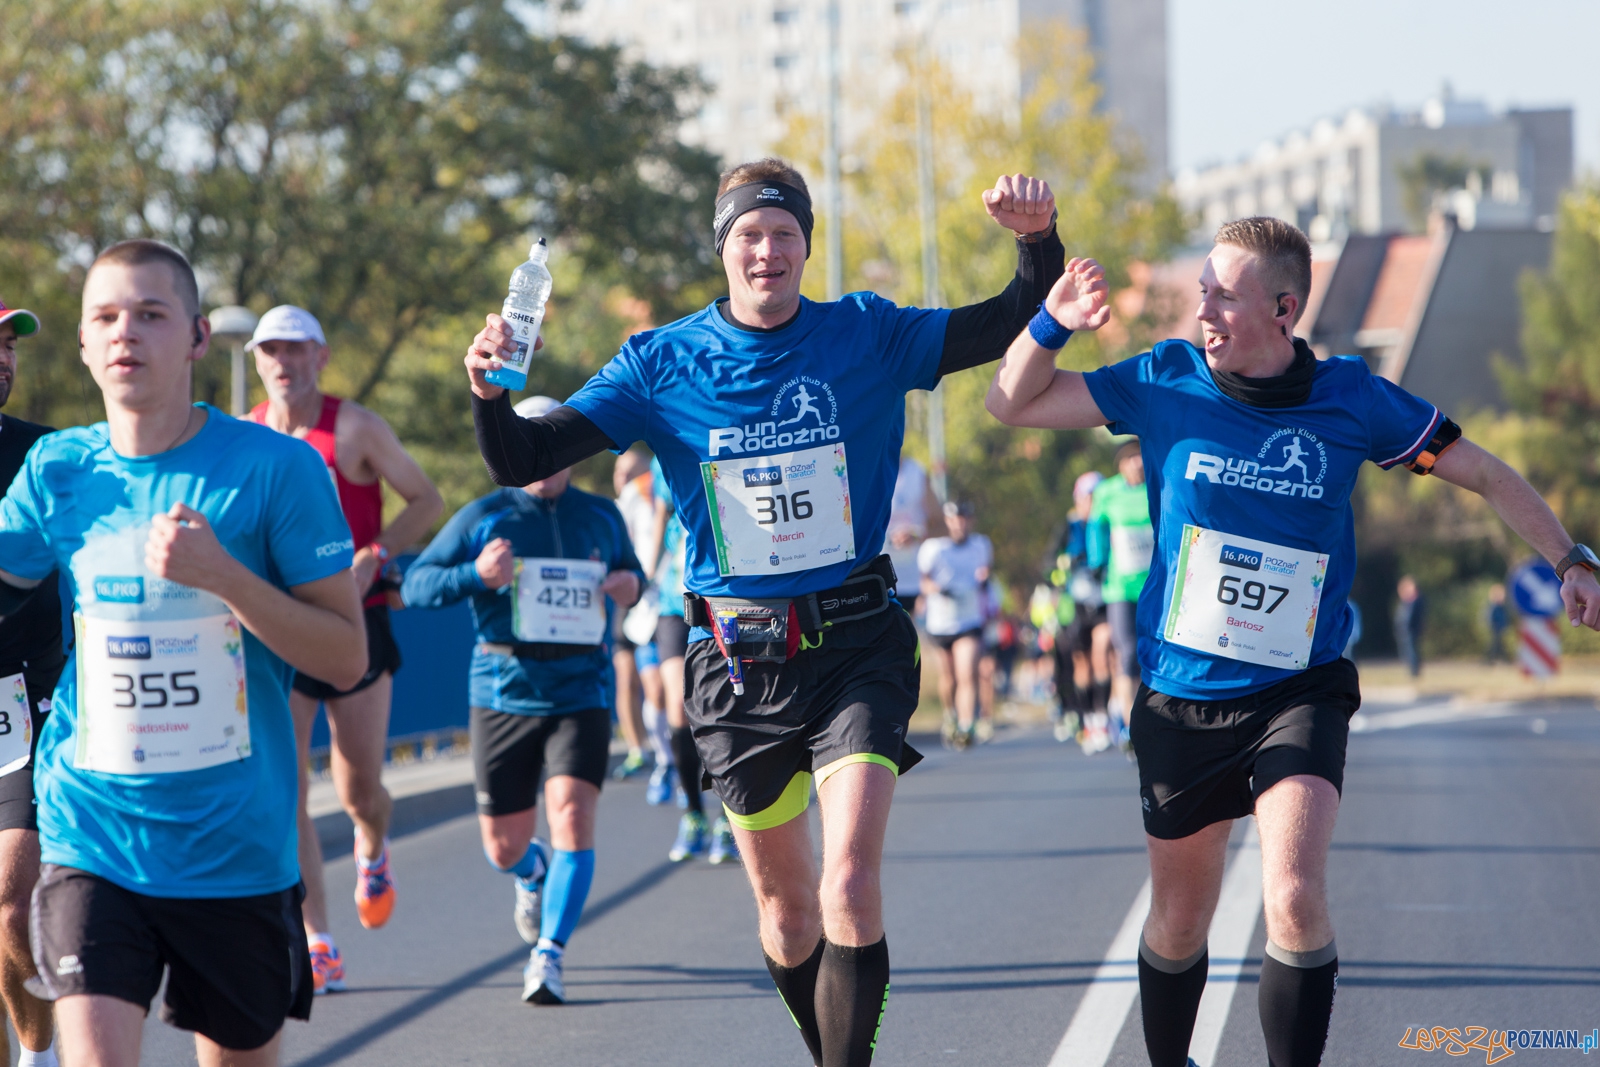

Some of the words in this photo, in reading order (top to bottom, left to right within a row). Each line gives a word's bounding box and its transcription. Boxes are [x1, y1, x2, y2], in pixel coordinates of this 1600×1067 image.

[507, 311, 535, 325] OSHEE
[801, 375, 821, 386] Klub
[821, 382, 838, 424] Biegacza
[1298, 427, 1317, 442] Klub
[1315, 441, 1328, 484] Biegacza
[785, 469, 816, 480] maraton
[755, 490, 813, 525] 316
[772, 531, 805, 543] Marcin
[1263, 564, 1296, 576] maraton
[537, 586, 592, 609] 4213
[840, 592, 869, 605] Kalenji
[1216, 575, 1290, 614] 697
[1226, 616, 1265, 632] Bartosz
[113, 671, 200, 708] 355
